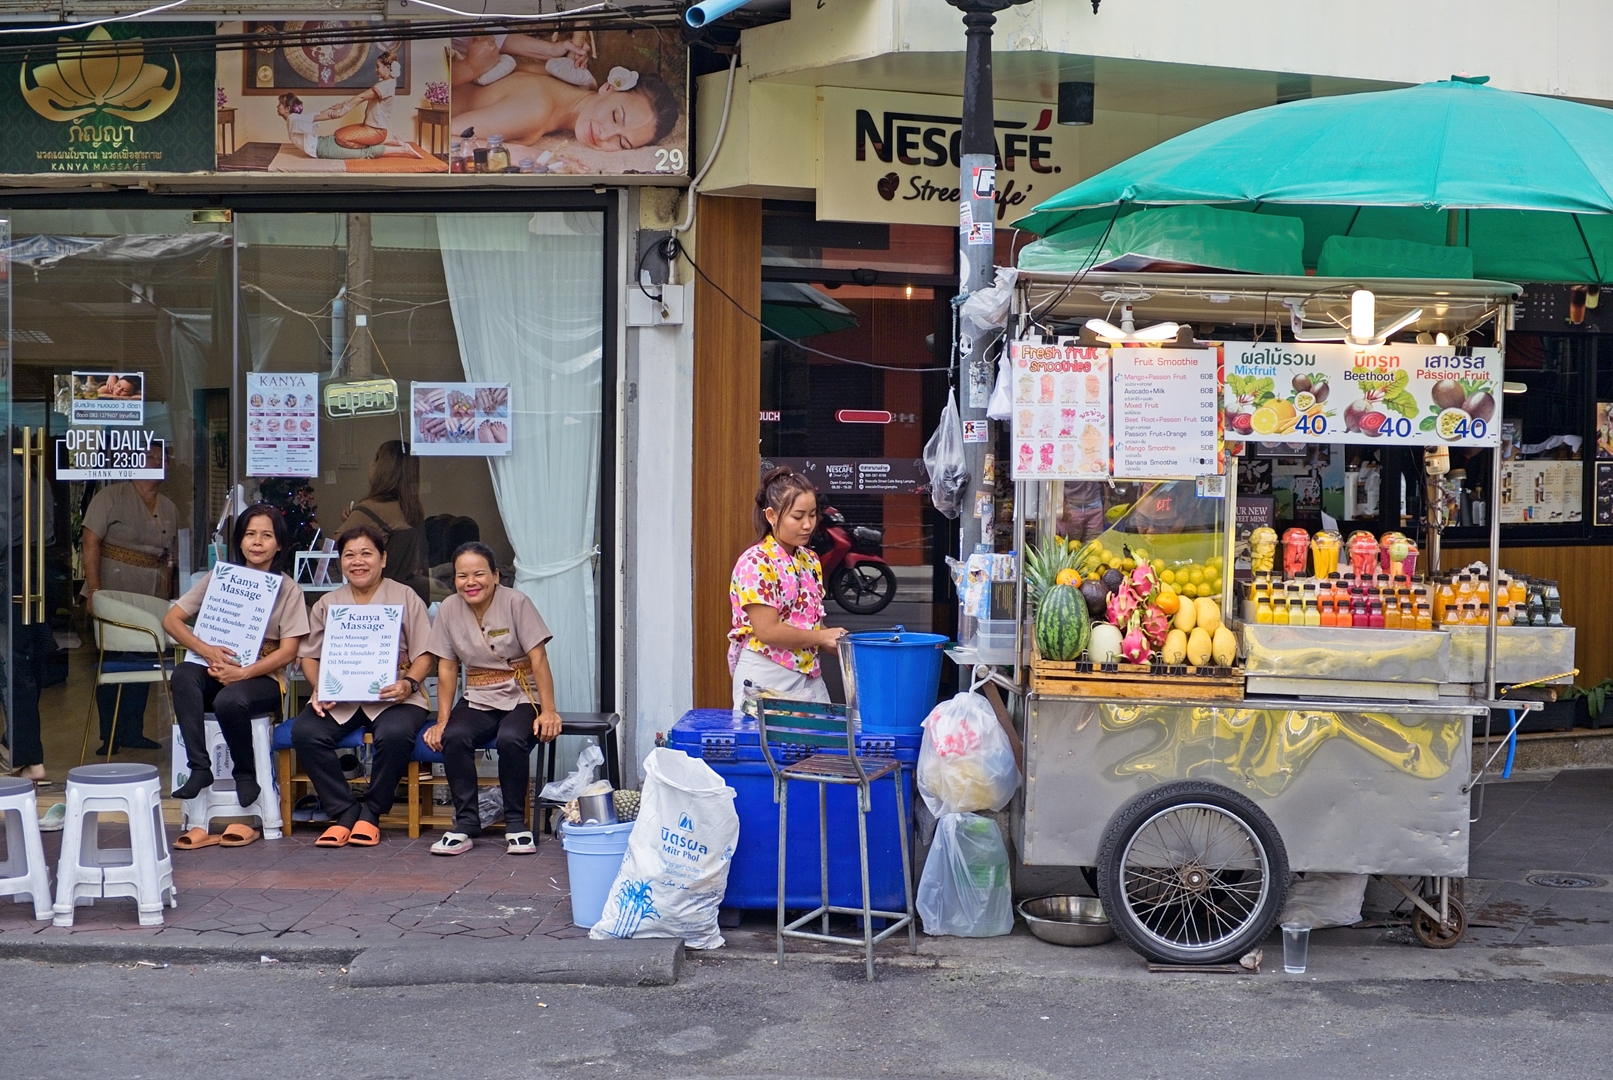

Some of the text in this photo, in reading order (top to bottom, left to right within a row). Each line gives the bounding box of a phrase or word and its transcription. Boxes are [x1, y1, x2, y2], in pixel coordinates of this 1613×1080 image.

[36, 147, 98, 160] นวดแผนโบราณ
[654, 148, 684, 170] 29
[51, 162, 147, 171] KANYA MASSAGE
[902, 176, 960, 201] Stree
[1022, 345, 1098, 360] Fresh fruit
[1241, 348, 1316, 366] ผลไม้รวม
[1029, 360, 1092, 373] smoothies
[1134, 358, 1198, 366] Fruit Smoothie
[1354, 350, 1400, 373] บีทรูท
[1424, 354, 1486, 369] เสาวรส
[1234, 365, 1277, 377] Mixfruit
[1344, 370, 1394, 382] Beethoot
[1416, 369, 1490, 381] Passion Fruit
[260, 376, 306, 386] KANYA
[338, 390, 387, 416] open
[66, 429, 154, 451] OPEN DAILY
[113, 452, 146, 468] 23:00
[1248, 506, 1268, 515] NEW
[230, 574, 259, 589] Kanya
[220, 583, 262, 601] Massage
[222, 598, 244, 608] Massage
[219, 607, 241, 617] Massage
[349, 614, 380, 623] Kanya
[210, 624, 230, 634] Massage
[222, 618, 245, 628] Shoulder
[340, 622, 384, 631] Massage
[217, 638, 239, 648] minutes
[661, 826, 708, 855] มิตรผล
[662, 844, 699, 862] Mitr Phol
